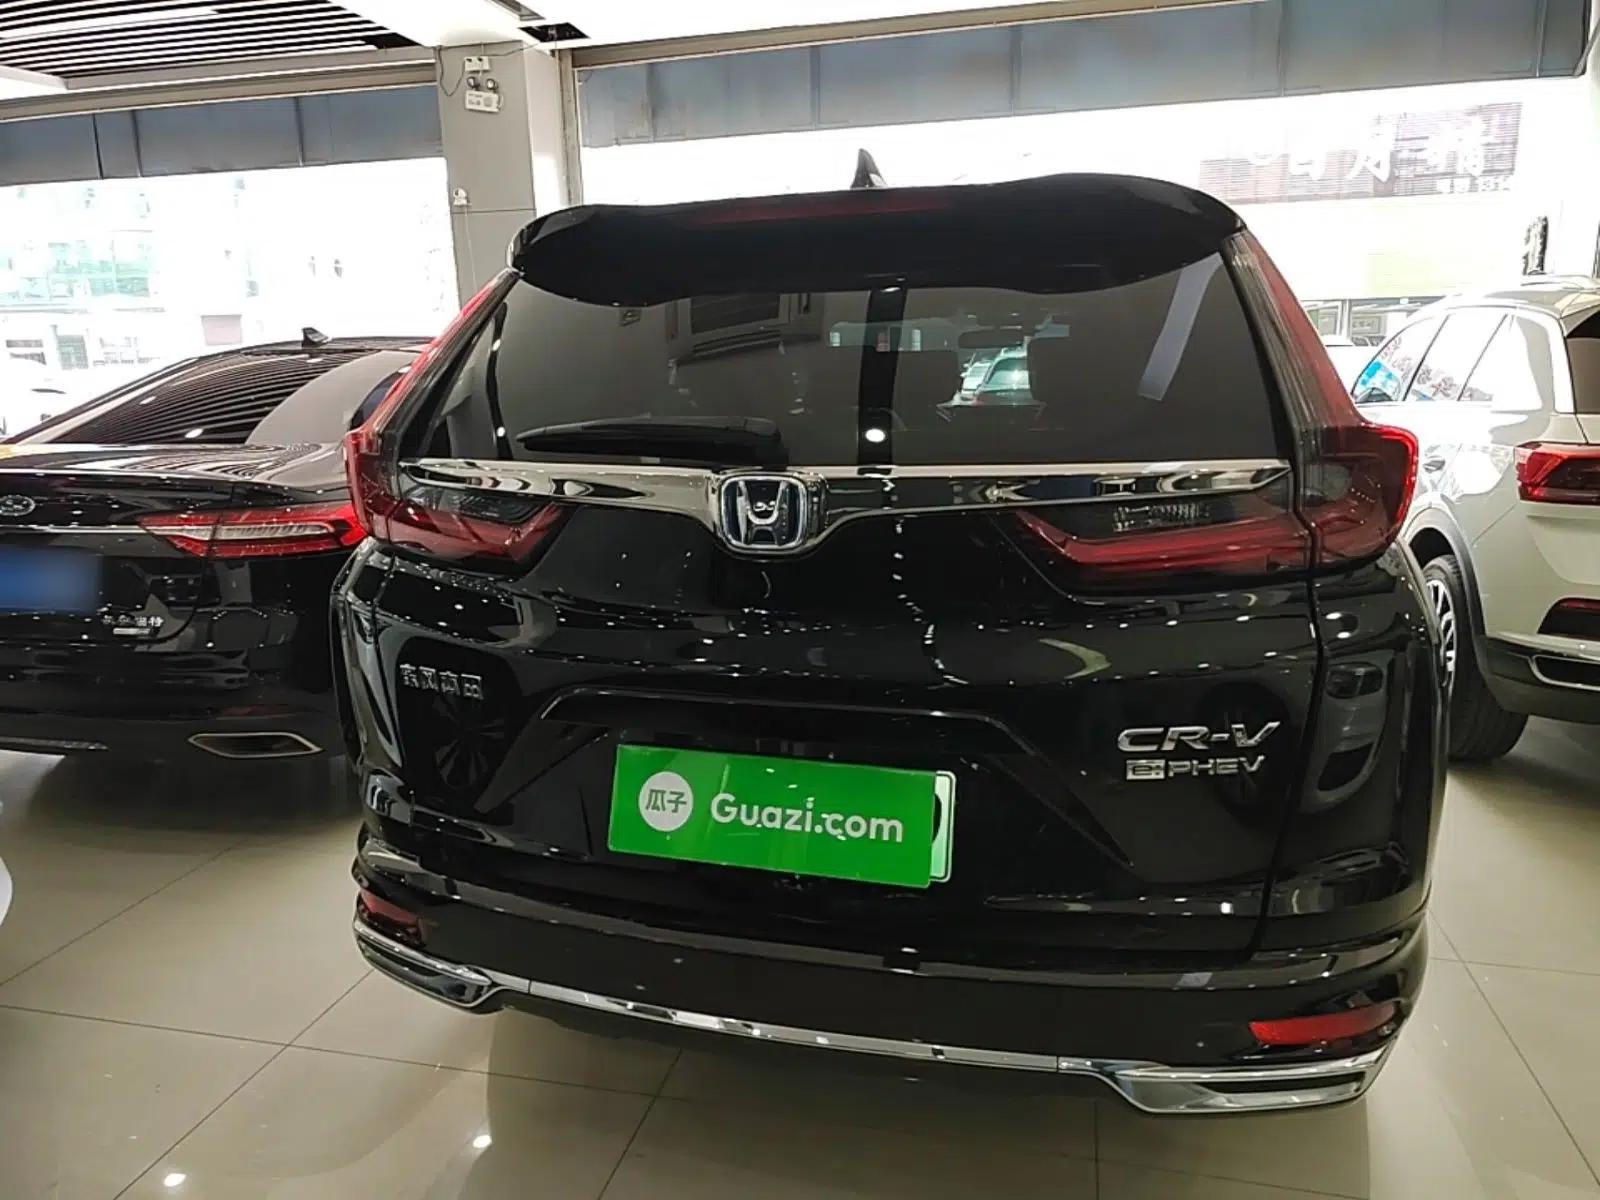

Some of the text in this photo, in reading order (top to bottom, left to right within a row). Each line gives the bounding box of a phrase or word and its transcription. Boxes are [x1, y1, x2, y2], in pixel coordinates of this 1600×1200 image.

[1118, 721, 1280, 751] CR-V
[645, 788, 688, 814] 瓜子
[710, 791, 905, 843] Guazi.com
